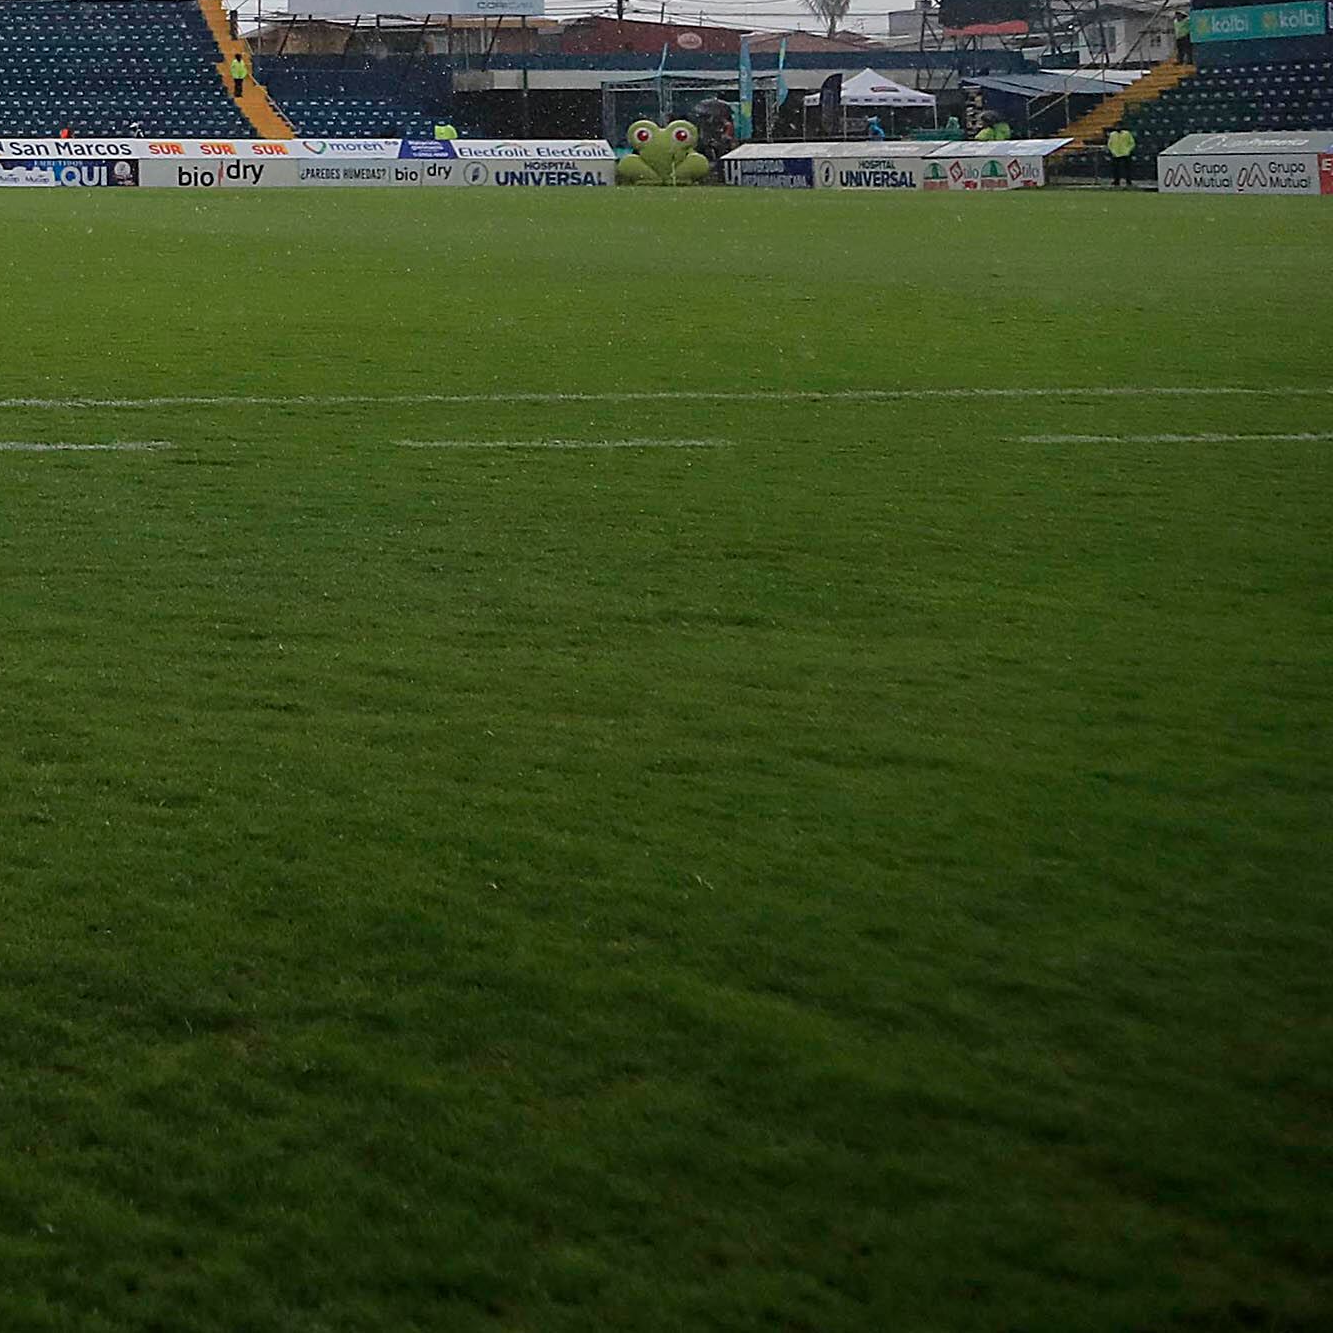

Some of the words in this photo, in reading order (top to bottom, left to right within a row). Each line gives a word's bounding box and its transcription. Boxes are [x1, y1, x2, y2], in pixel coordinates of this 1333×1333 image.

[9, 142, 50, 156] San
[54, 141, 132, 156] Marcos
[149, 142, 182, 155] SUR
[200, 143, 234, 155] SUR
[252, 143, 286, 155] SUR
[458, 146, 530, 157] Electrolit
[536, 146, 610, 157] Electrolit
[524, 161, 578, 170] HOSPITAL
[858, 160, 895, 170] HOSPITAL
[1193, 162, 1228, 175] Grupo
[1269, 161, 1305, 175] Grupo
[178, 166, 214, 186] bio
[226, 158, 264, 184] dry
[395, 167, 418, 181] bio
[427, 163, 452, 179] dry
[495, 171, 607, 186] UNIVERSAL
[840, 171, 916, 188] UNIVERSAL
[1194, 176, 1232, 188] Mutual
[1270, 176, 1311, 188] Mutual
